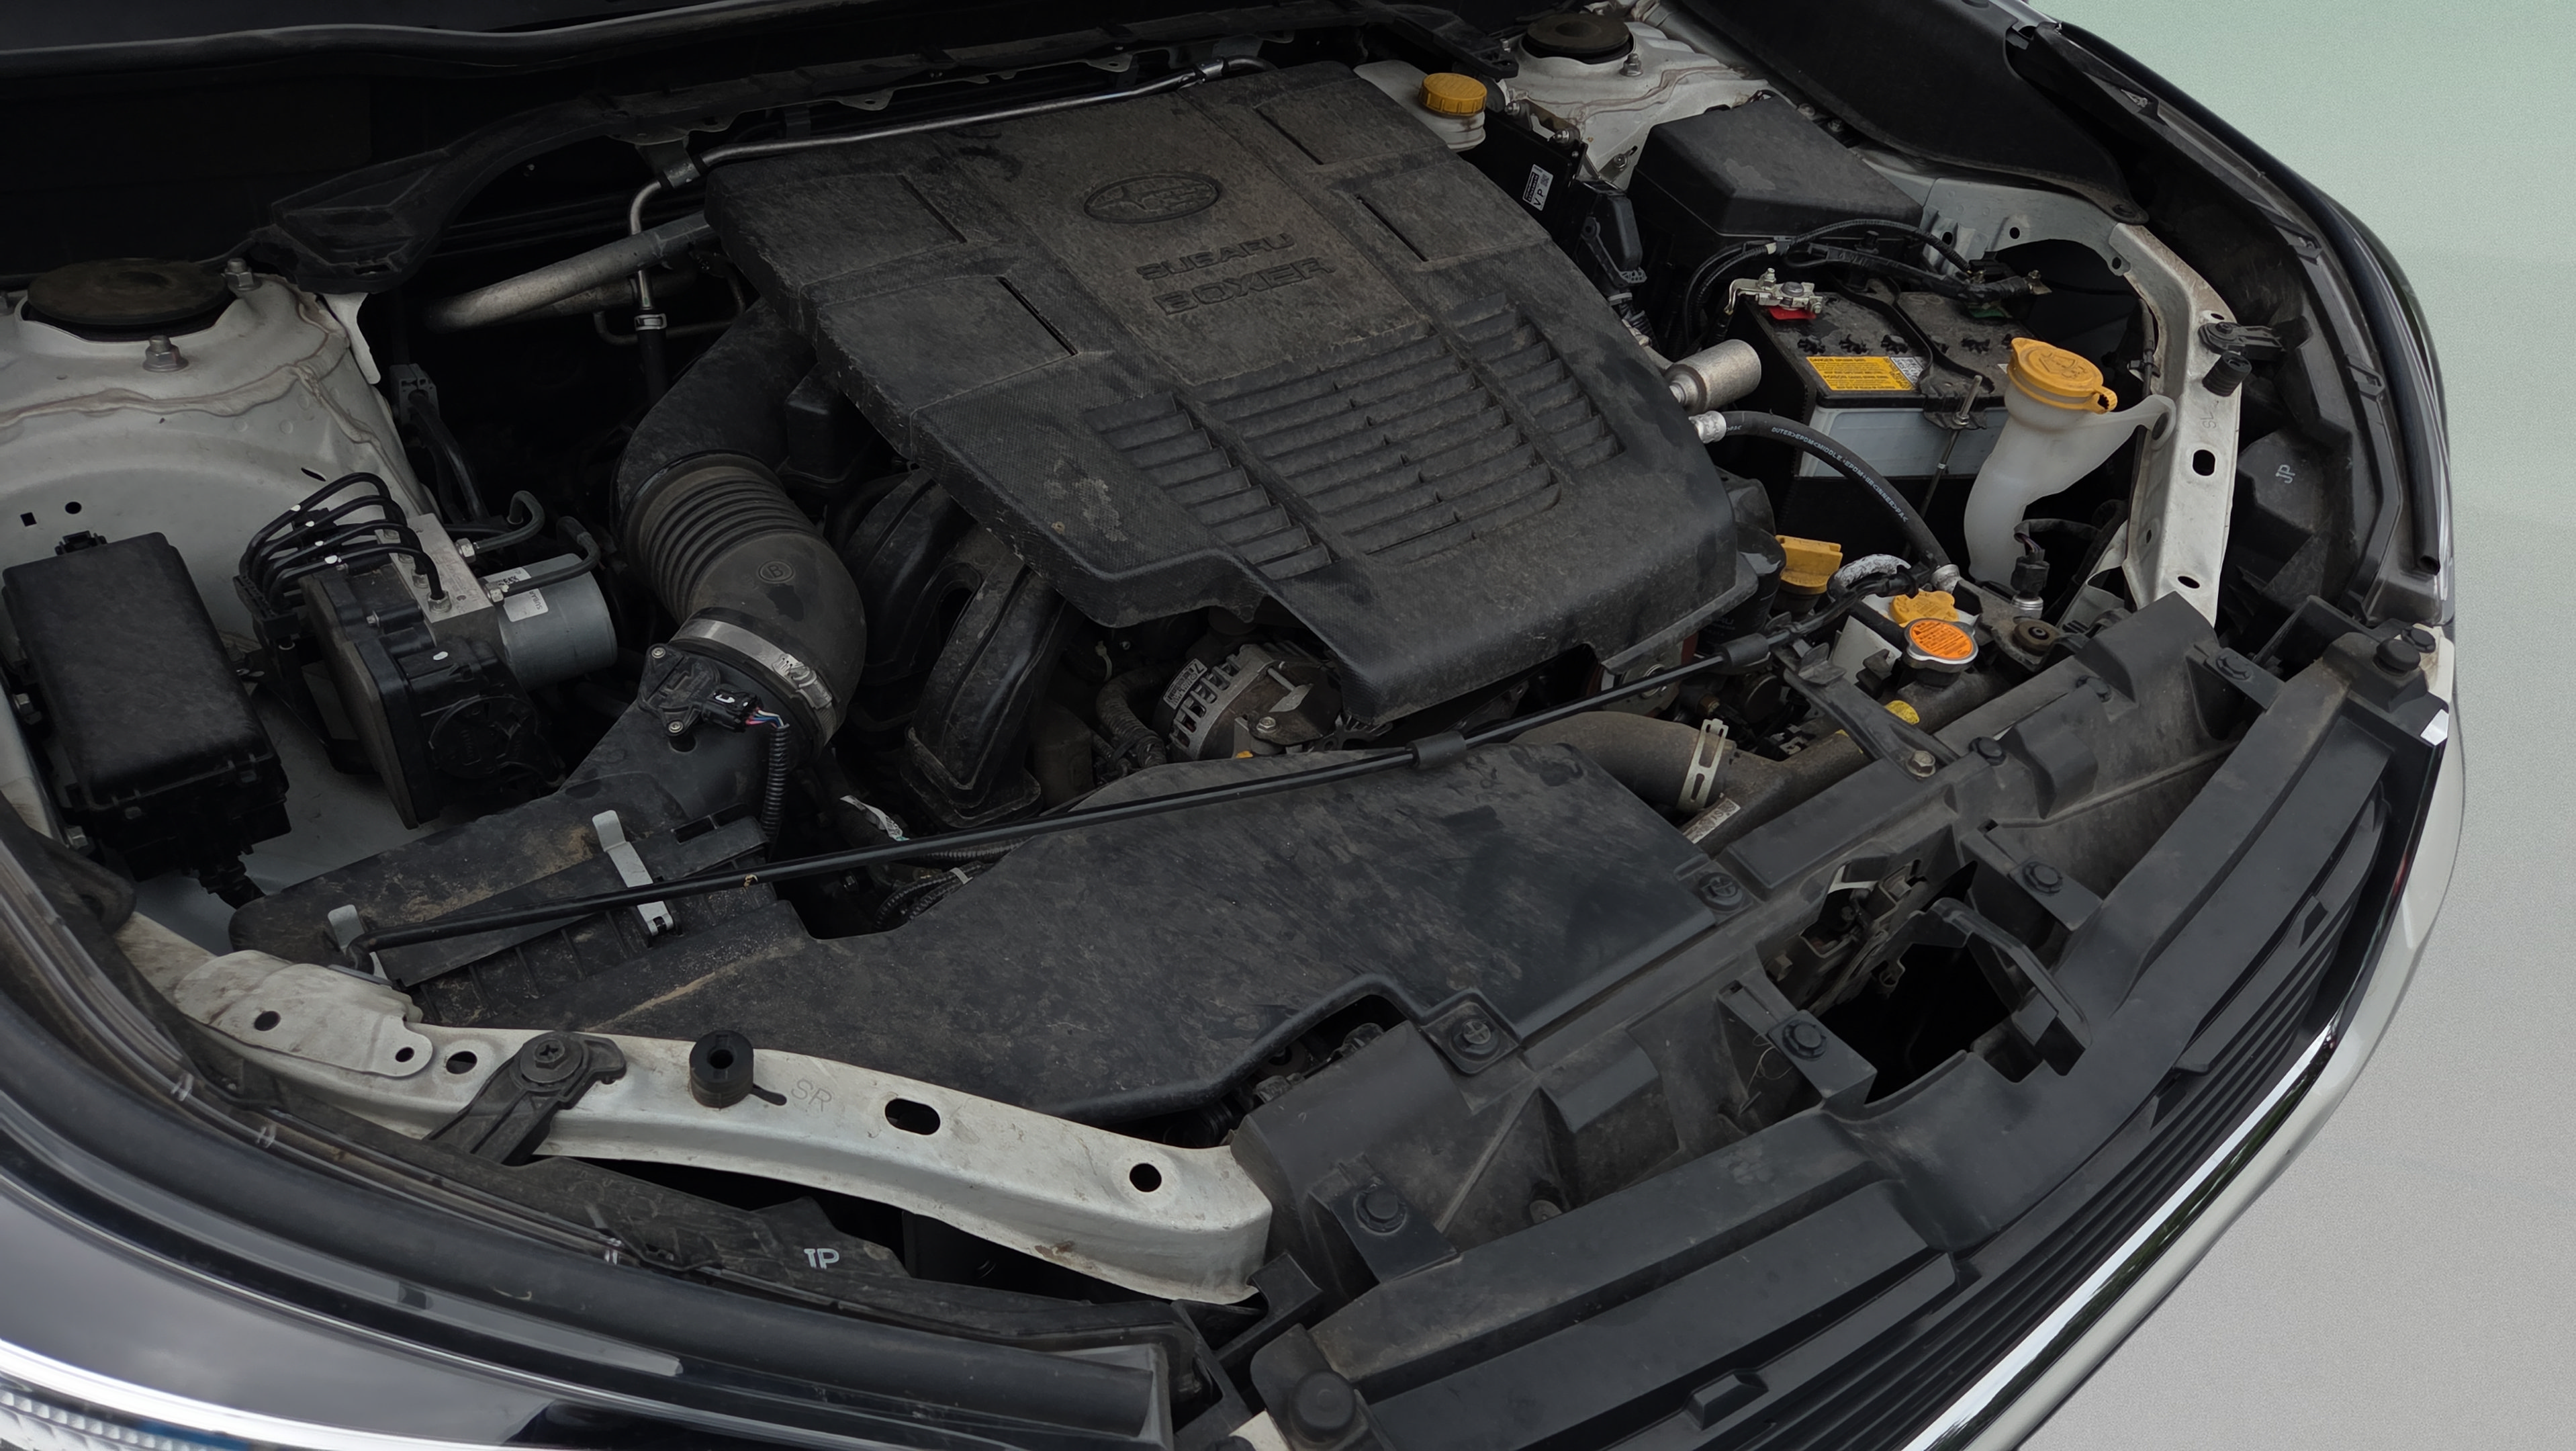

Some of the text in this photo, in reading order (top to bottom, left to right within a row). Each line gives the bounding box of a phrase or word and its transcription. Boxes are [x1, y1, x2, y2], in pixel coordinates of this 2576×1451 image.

[1136, 232, 1296, 281] SUBARU
[1153, 257, 1335, 315] BOXER
[2275, 464, 2295, 484] JP
[767, 565, 784, 578] B
[529, 591, 543, 610] SUBAR
[791, 1078, 833, 1112] SR
